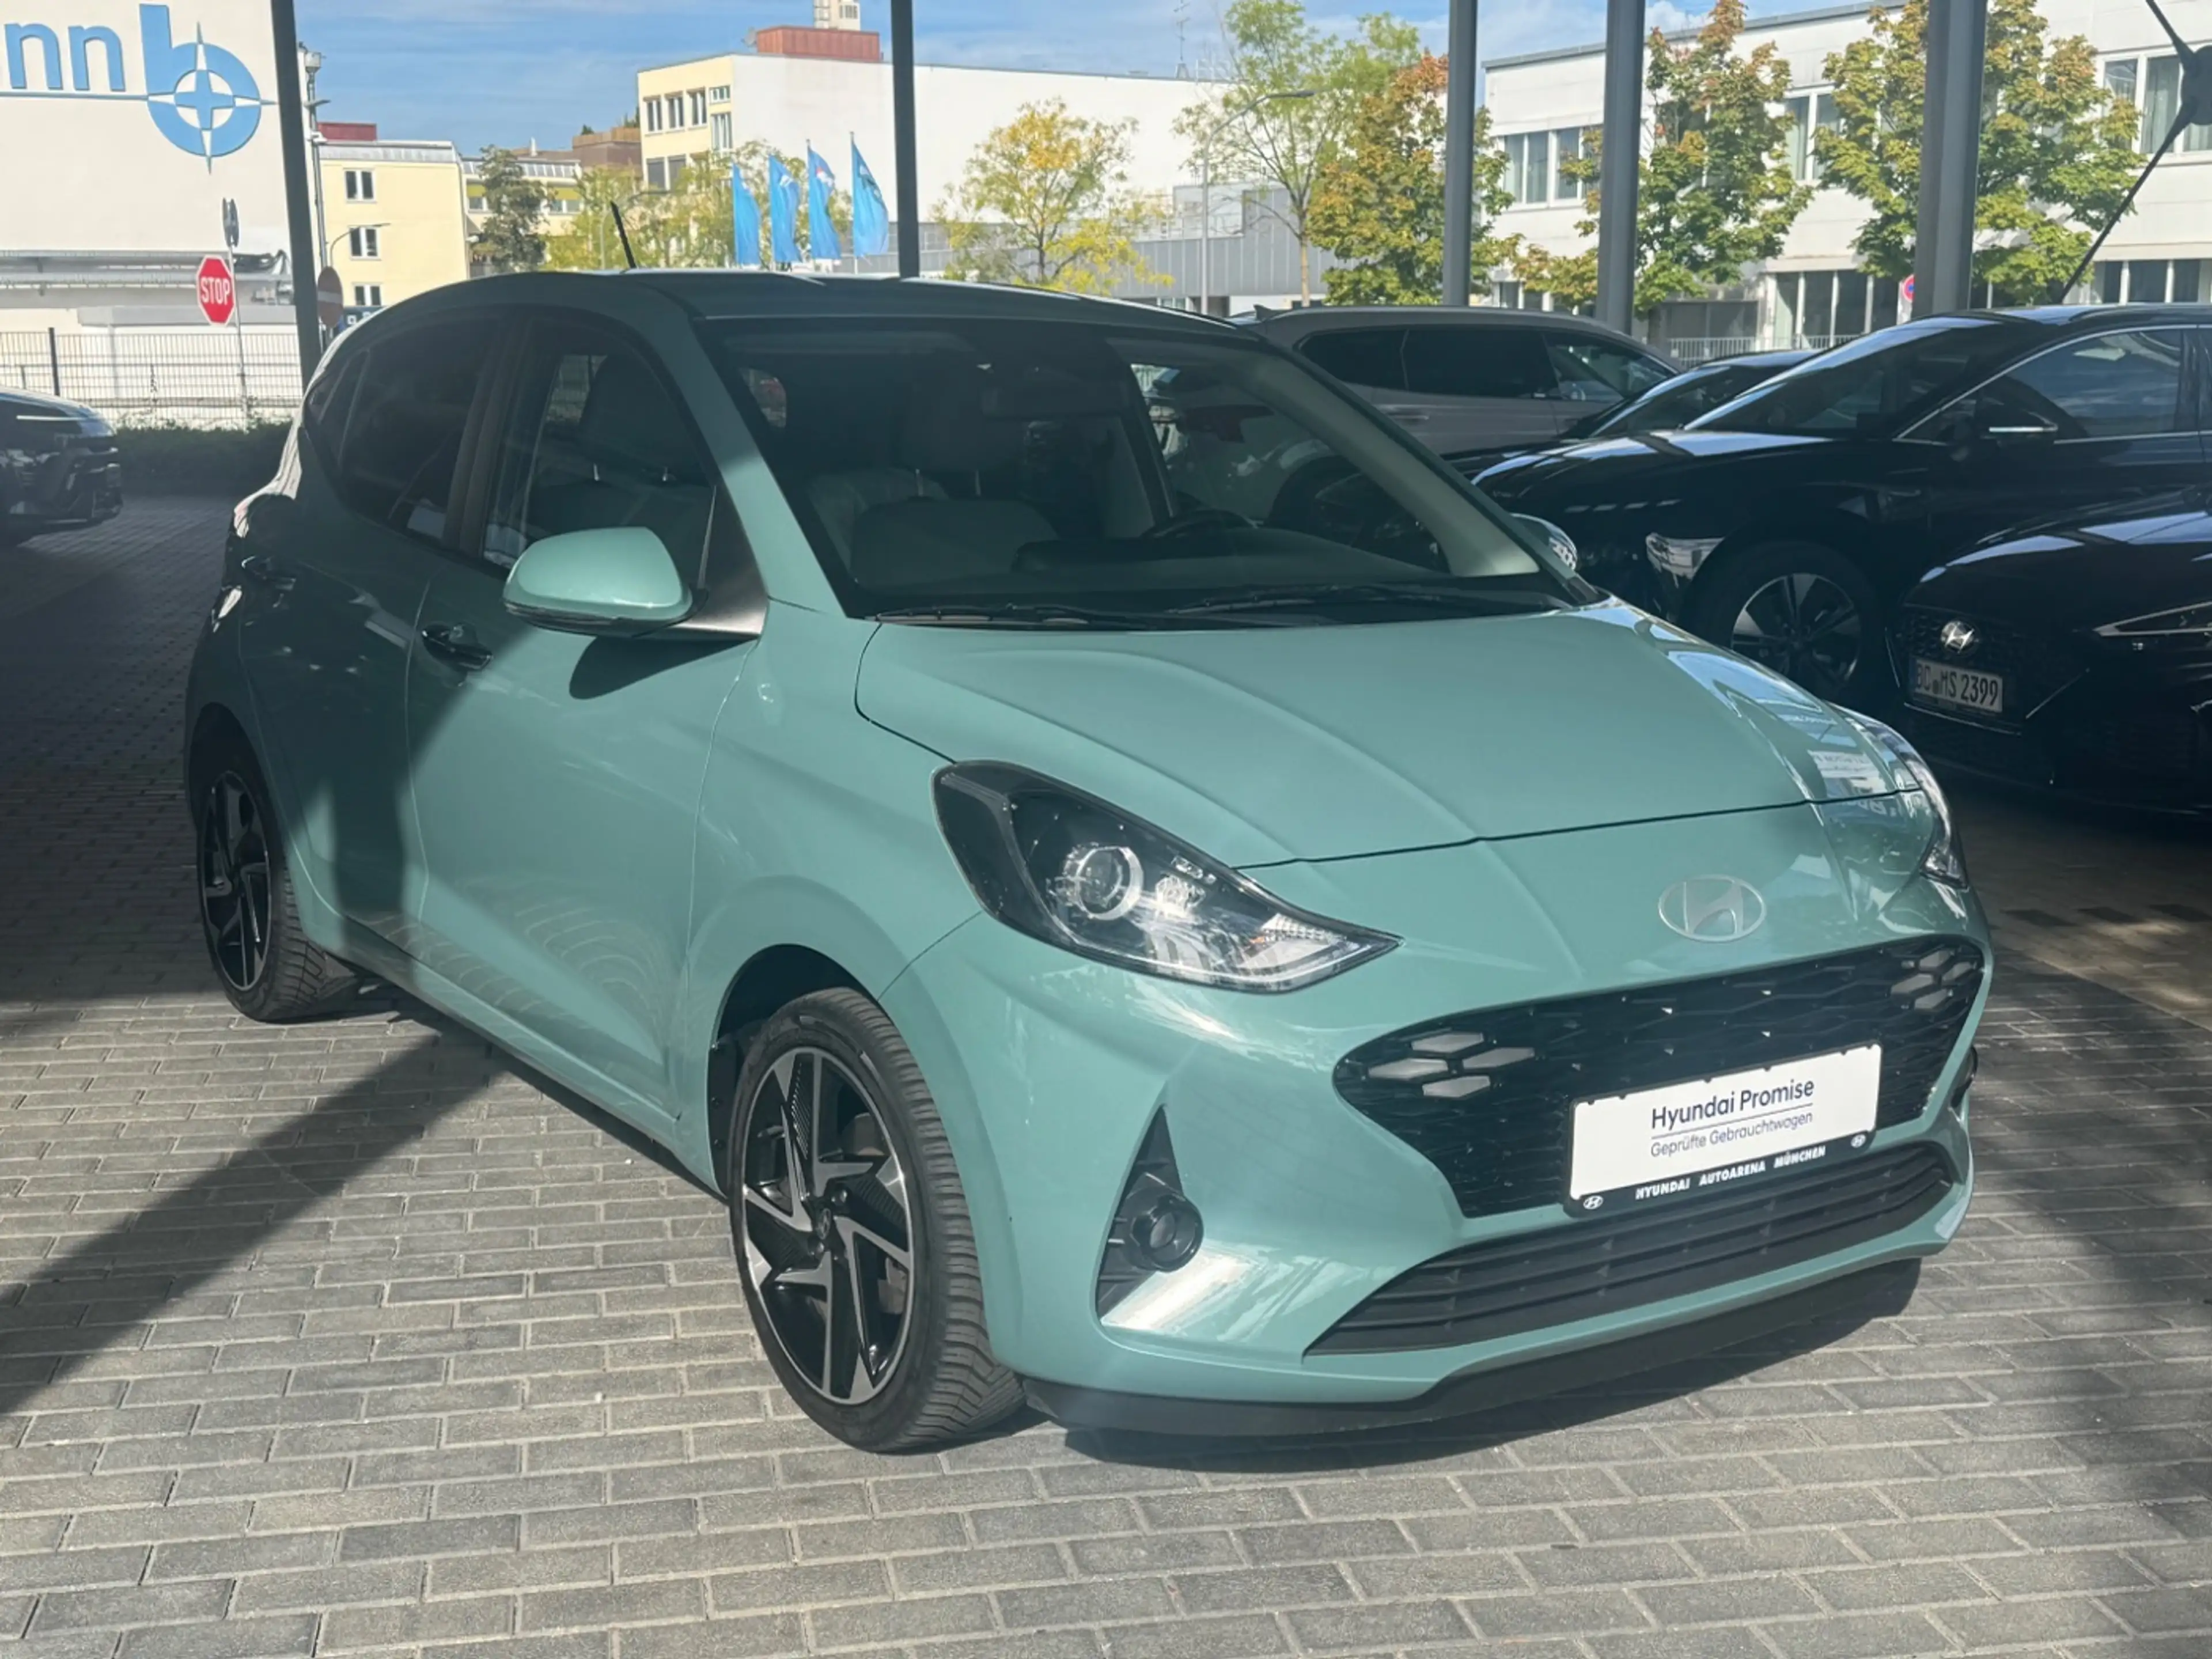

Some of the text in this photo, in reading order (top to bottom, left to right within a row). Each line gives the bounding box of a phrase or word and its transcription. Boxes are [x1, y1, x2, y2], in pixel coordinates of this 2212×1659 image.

[200, 277, 230, 305] STOP
[1941, 669, 1957, 698] MS
[1961, 673, 1998, 706] 2399
[1651, 1078, 1815, 1131] Hyundai Promise
[1650, 1111, 1814, 1157] Geprüfte Gebrauchtwagen
[1635, 1145, 1826, 1200] HYUNDAI AUTOARENA MÜNCHEN
